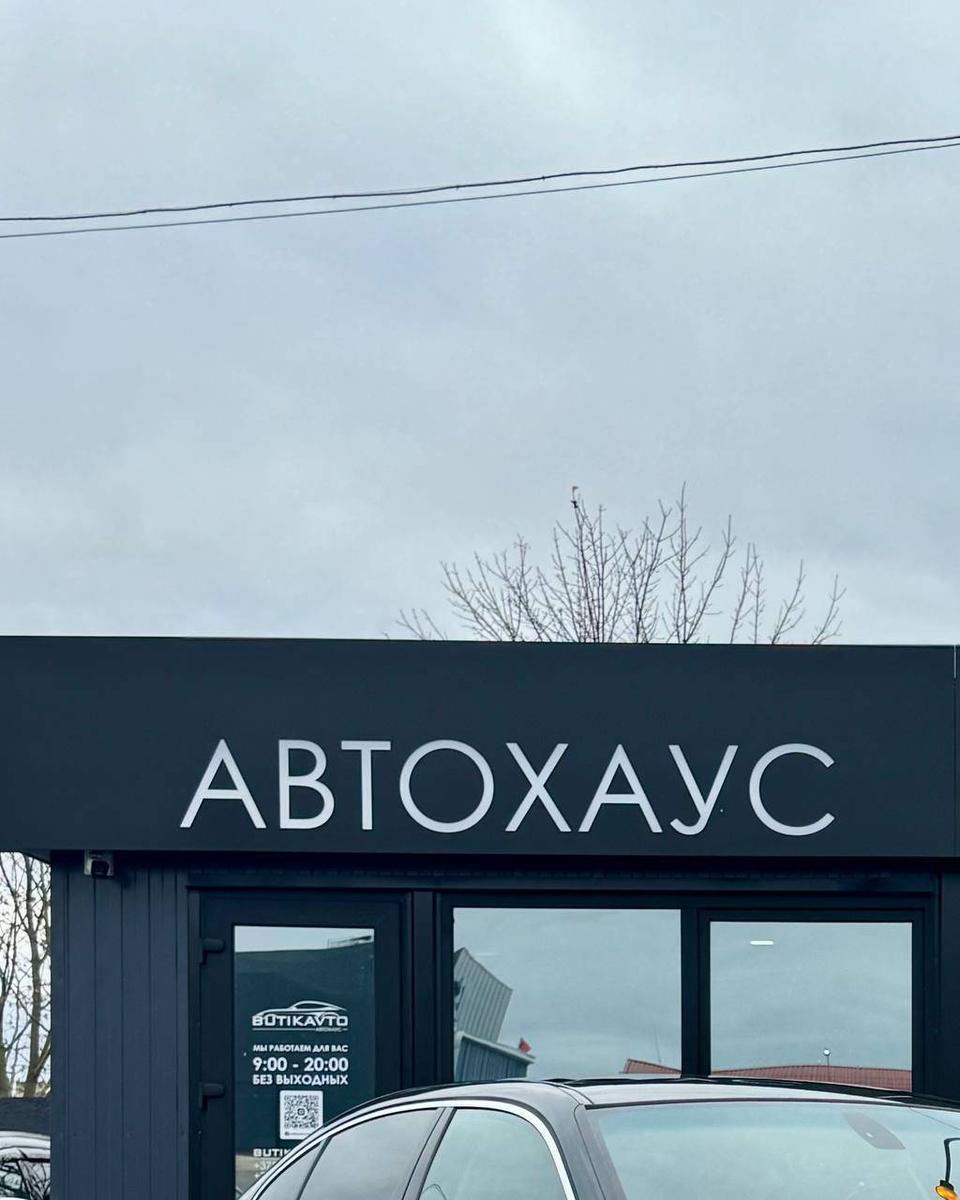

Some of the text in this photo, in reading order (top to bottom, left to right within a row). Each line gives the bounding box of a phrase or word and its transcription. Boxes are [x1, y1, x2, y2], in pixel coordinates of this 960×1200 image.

[180, 739, 835, 837] АВТОХАУС
[252, 1015, 348, 1027] BUTIKAVTO
[252, 1044, 349, 1053] МЫ РАБОТАЕМ ДЛЯ ВАС
[252, 1057, 287, 1072] 9:00
[304, 1057, 349, 1072] 20:00
[253, 1075, 349, 1086] БЕЗ ВЫХОДНЫХ
